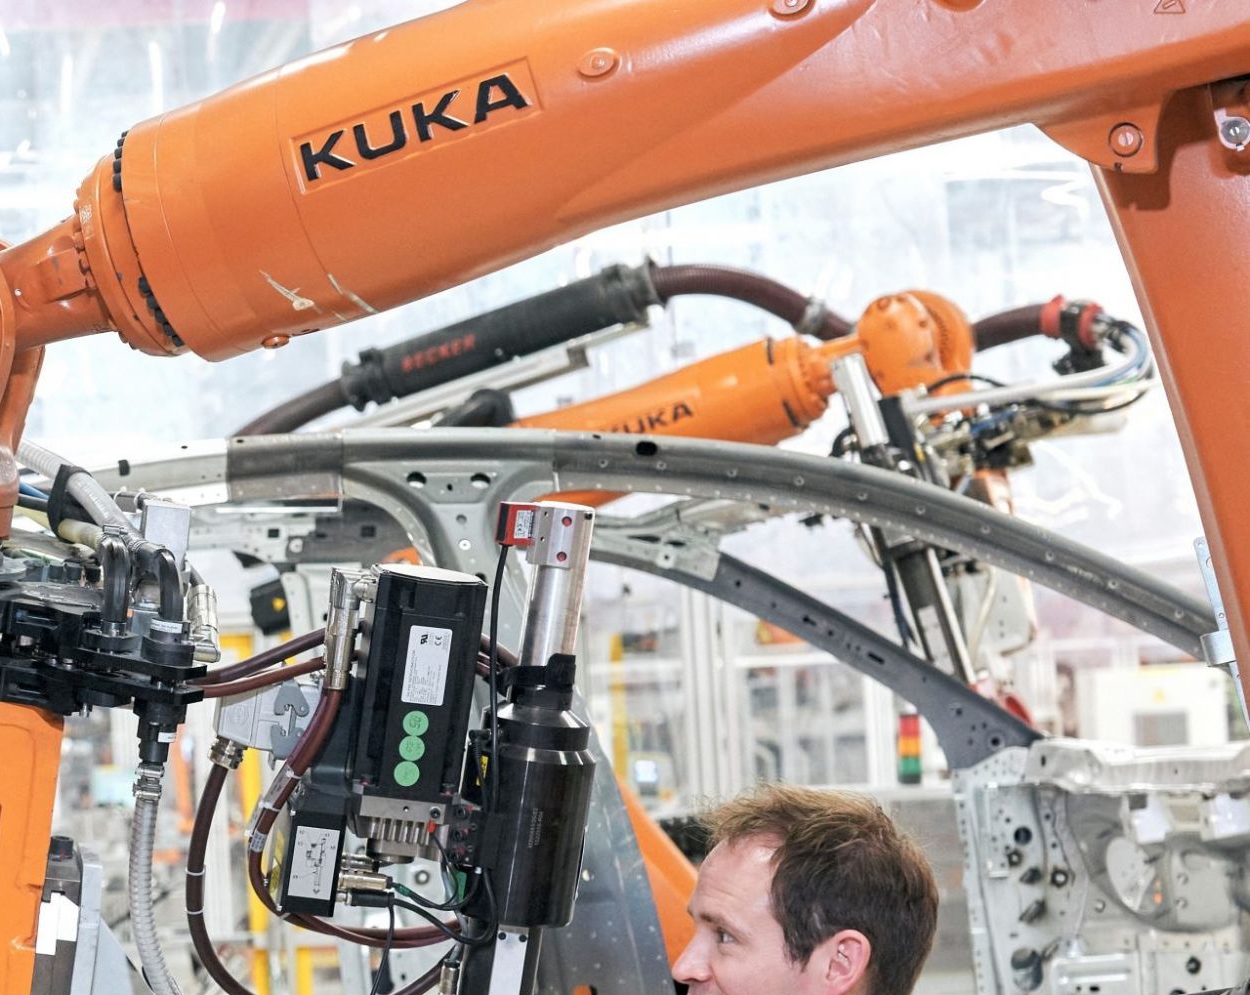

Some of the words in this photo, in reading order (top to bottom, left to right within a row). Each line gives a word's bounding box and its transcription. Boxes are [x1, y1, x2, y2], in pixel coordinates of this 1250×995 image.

[300, 73, 530, 181] KUKA
[401, 334, 477, 373] BECKER
[611, 402, 693, 433] UKA
